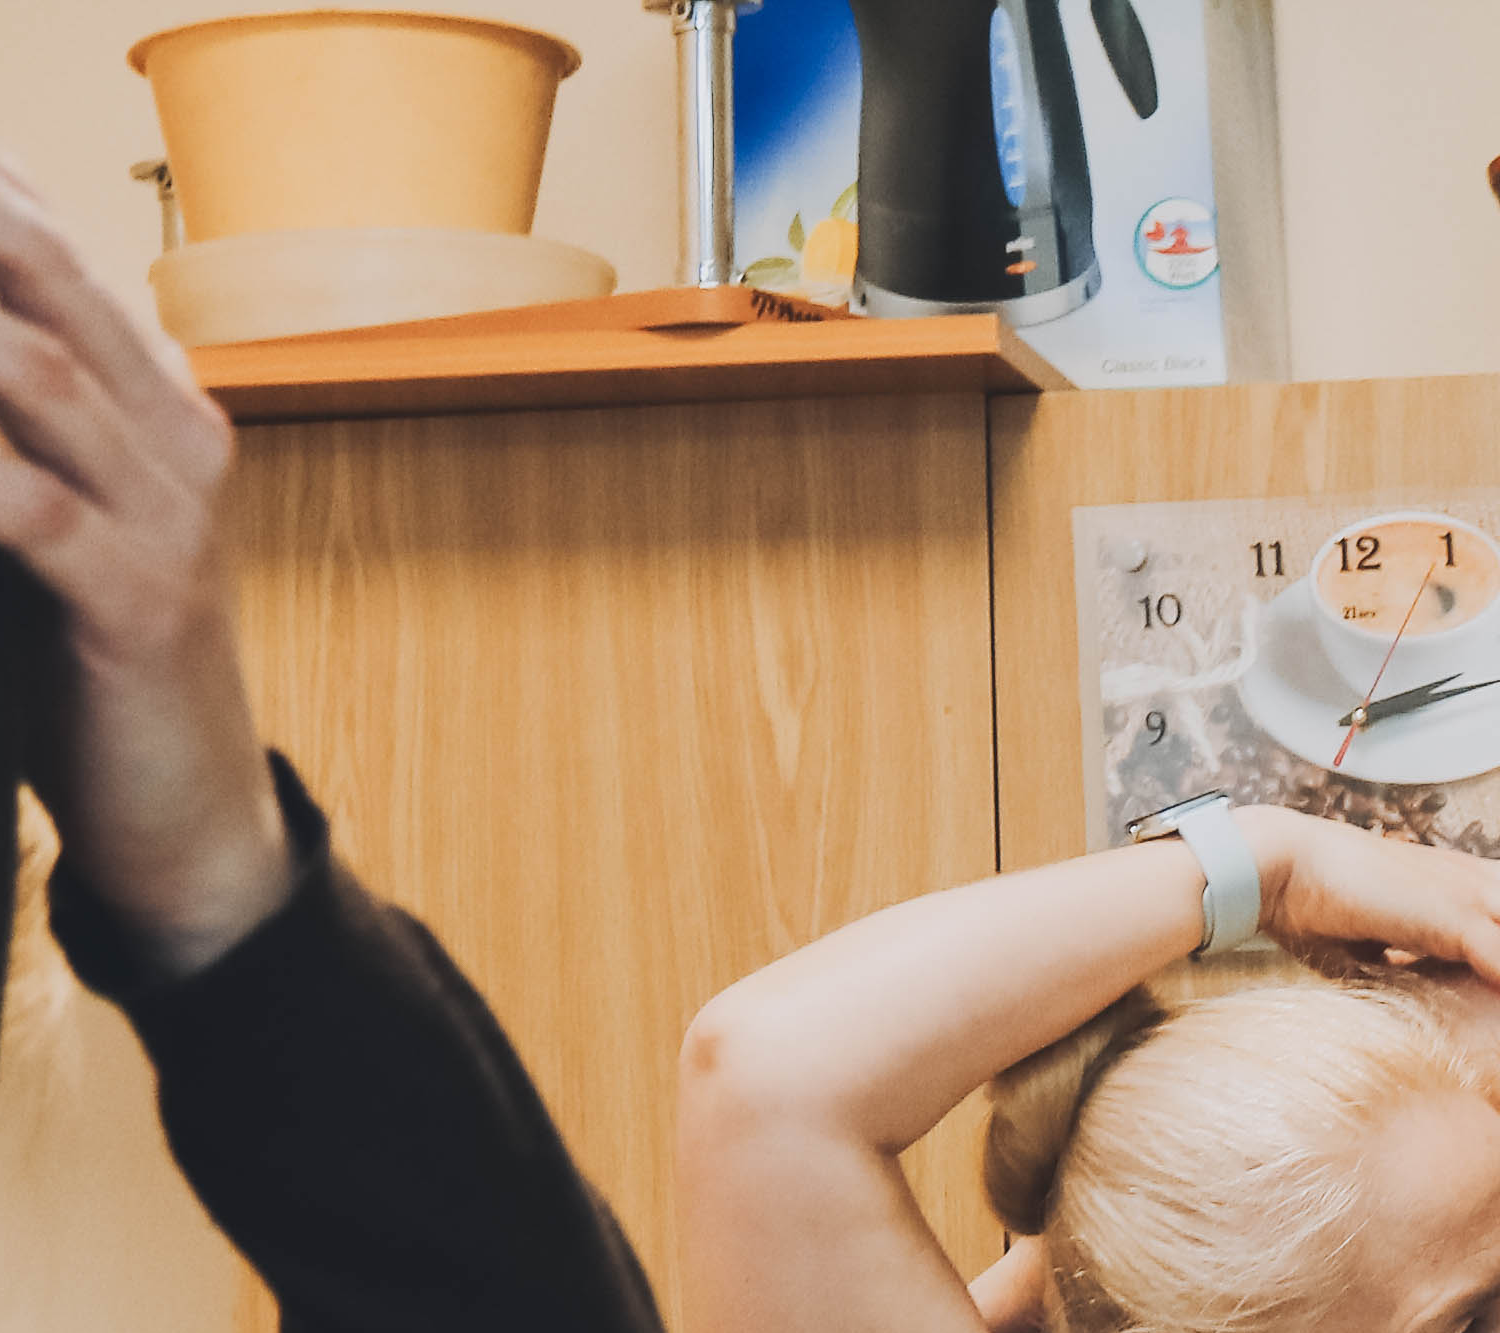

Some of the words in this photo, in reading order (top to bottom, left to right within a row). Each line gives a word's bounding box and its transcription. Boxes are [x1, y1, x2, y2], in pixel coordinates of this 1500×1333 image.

[1250, 541, 1285, 577] 11
[1335, 536, 1382, 572] 12
[1440, 531, 1455, 567] 1
[1138, 593, 1182, 629] 10
[1145, 711, 1166, 746] 9
